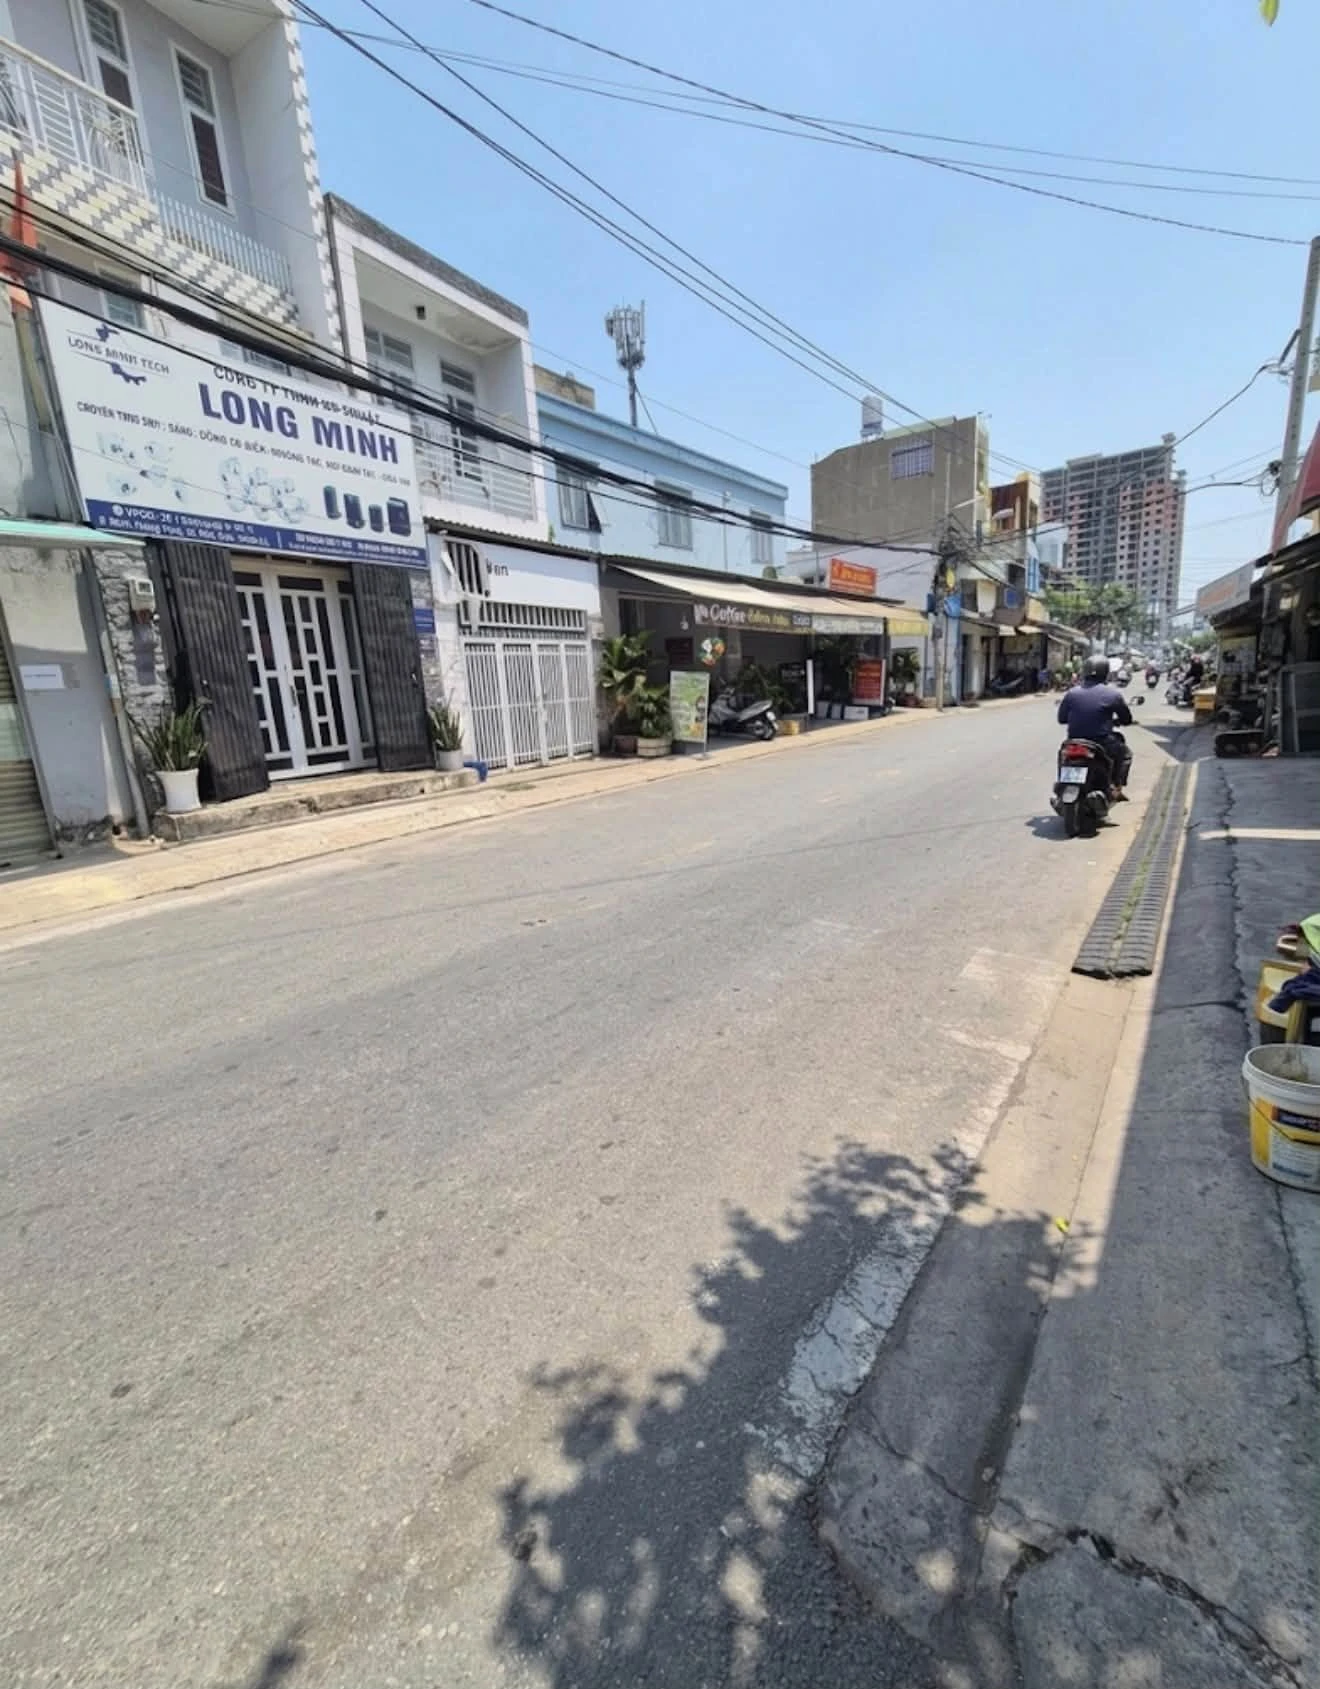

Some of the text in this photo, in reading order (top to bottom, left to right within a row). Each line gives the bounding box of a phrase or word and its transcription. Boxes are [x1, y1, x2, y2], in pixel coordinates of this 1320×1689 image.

[141, 358, 170, 375] TECH
[198, 382, 299, 439] LONG
[311, 415, 399, 464] MINH
